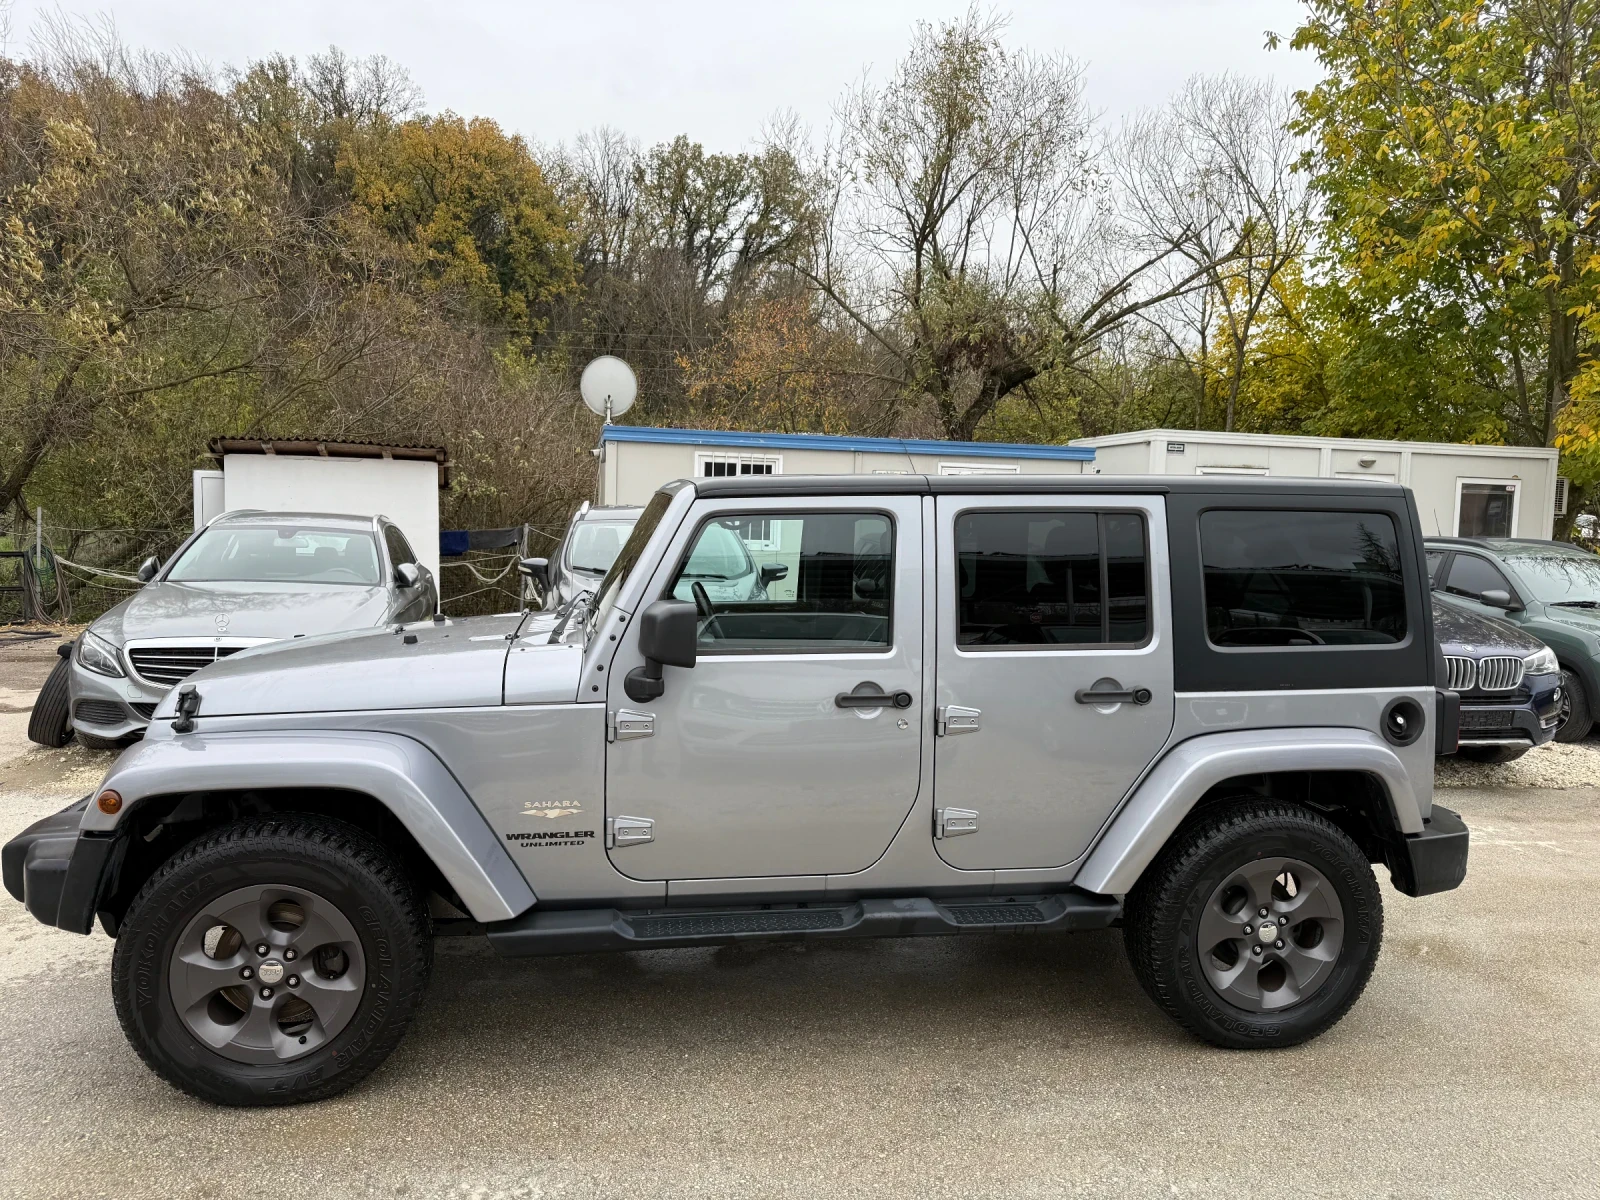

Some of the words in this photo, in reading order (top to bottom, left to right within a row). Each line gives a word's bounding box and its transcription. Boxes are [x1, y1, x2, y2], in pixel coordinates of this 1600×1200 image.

[506, 830, 595, 841] WRANGLER
[520, 840, 585, 848] UNLIMITED
[524, 800, 581, 809] SAHARA
[1308, 840, 1370, 945] YOKOHAMA
[136, 873, 216, 1008] YOKOHAMA
[336, 905, 394, 1070] GEOLANDAR
[1178, 945, 1282, 1037] GEOLANDAR
